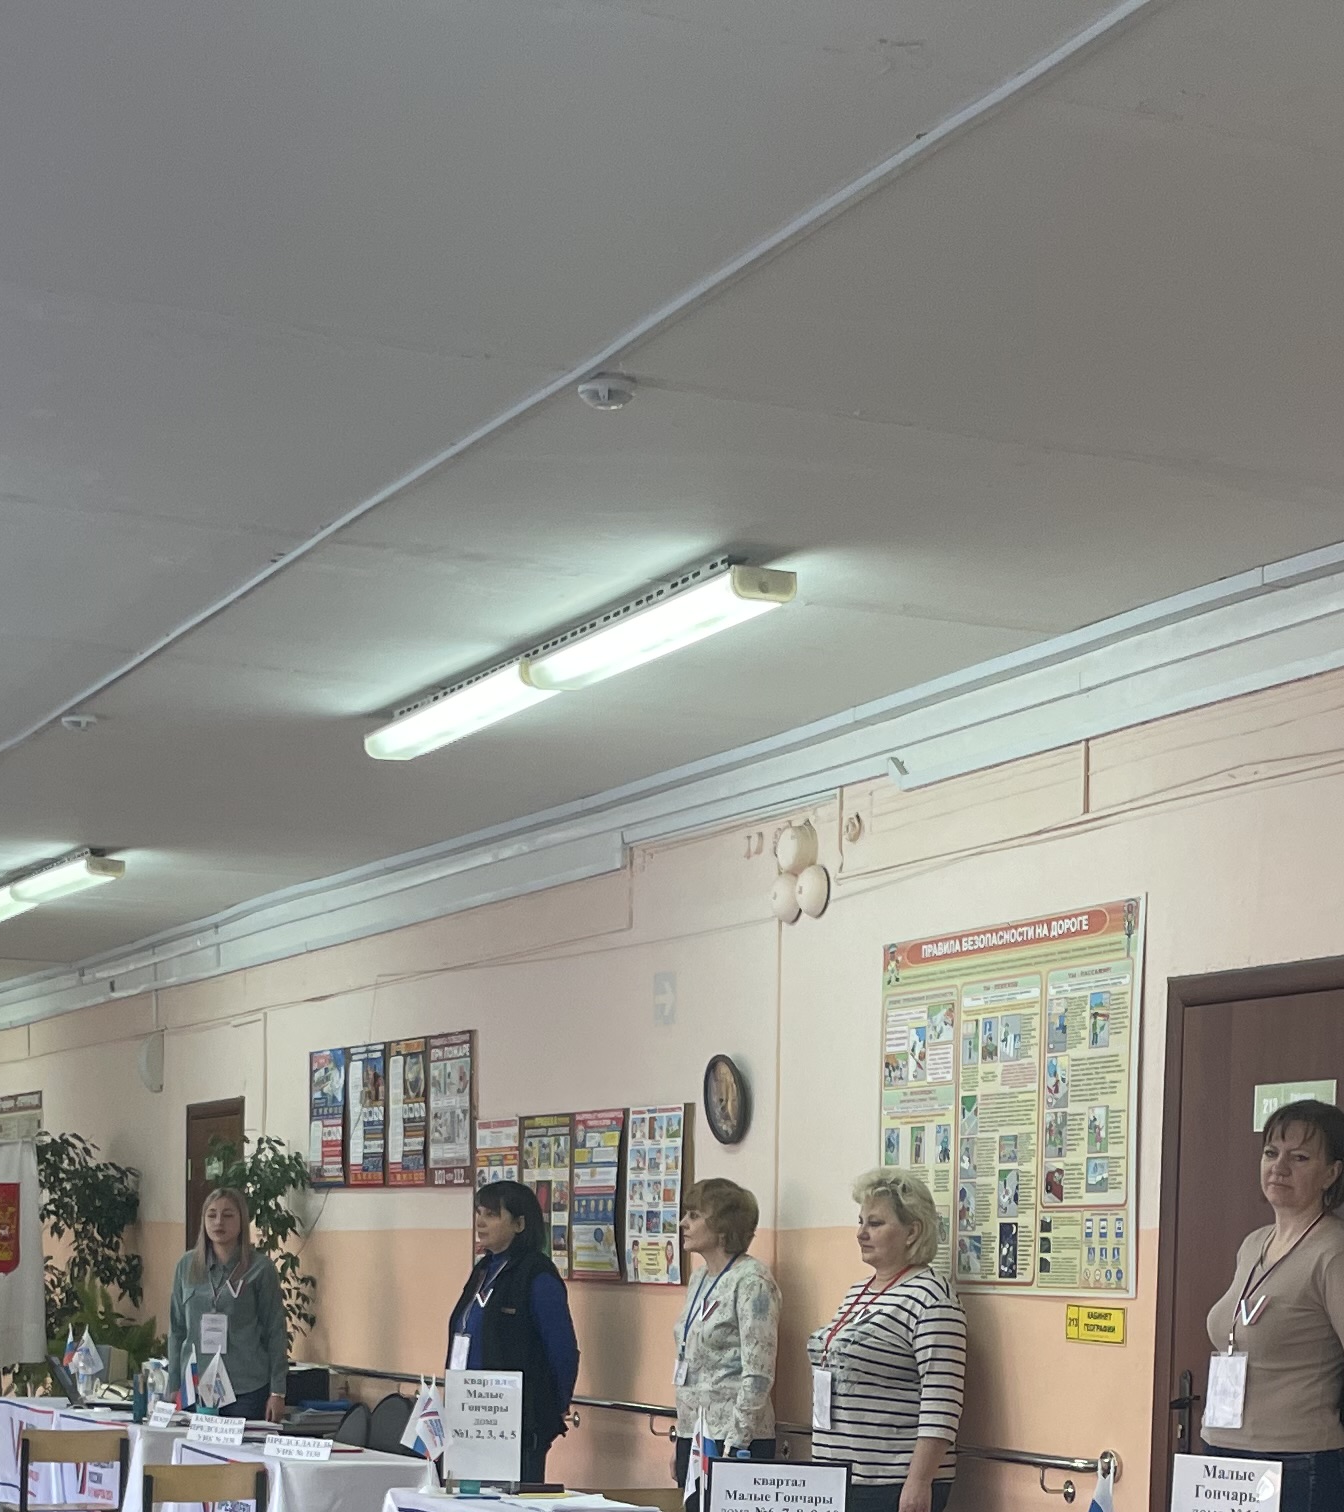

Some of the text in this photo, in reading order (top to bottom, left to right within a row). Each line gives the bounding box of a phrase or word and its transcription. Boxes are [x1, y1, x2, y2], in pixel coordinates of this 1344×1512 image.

[921, 915, 1090, 959] ПРАВИЛА БЕЗОПАСНОСТИ НА ДОРОГЕ
[466, 1389, 504, 1400] Малые
[461, 1402, 509, 1414] Гончары
[510, 1430, 517, 1439] 5
[1203, 1464, 1255, 1482] Малые
[753, 1477, 806, 1489] квартал
[725, 1489, 833, 1506] Малые Гончары
